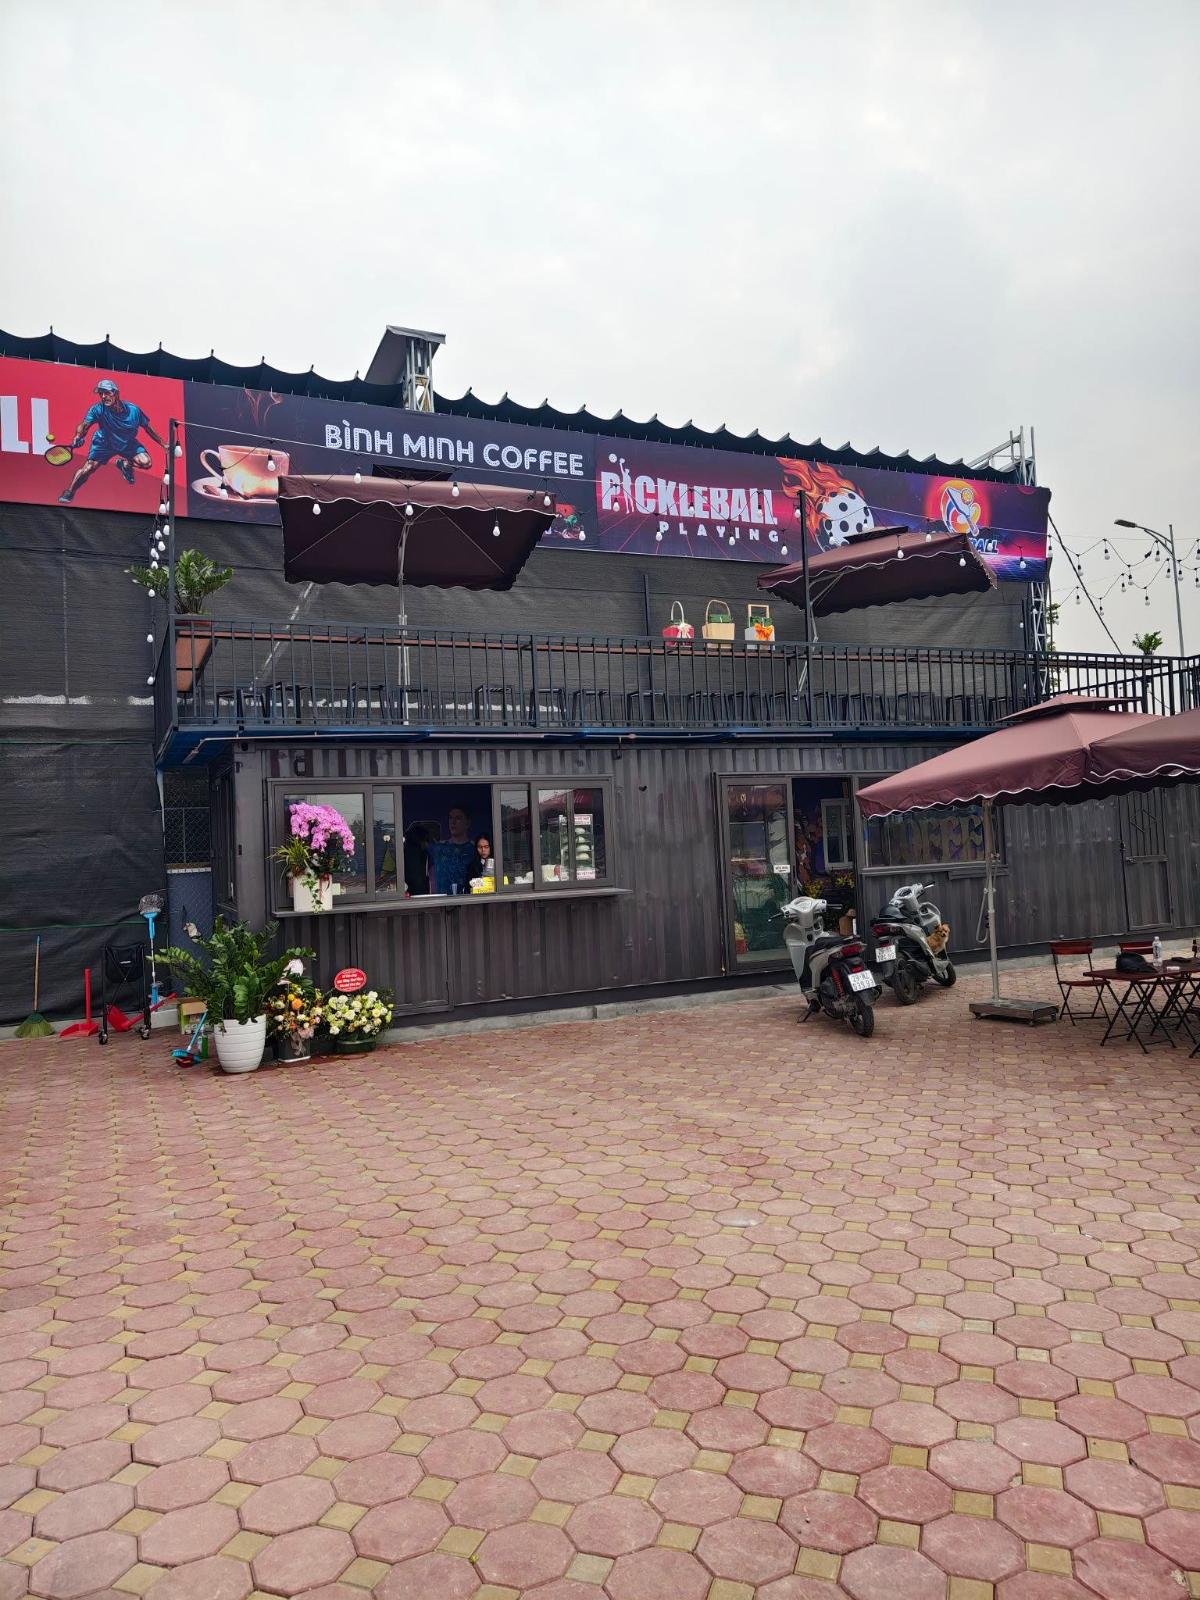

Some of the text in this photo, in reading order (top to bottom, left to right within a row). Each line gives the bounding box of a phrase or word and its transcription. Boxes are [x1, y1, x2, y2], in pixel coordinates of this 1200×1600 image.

[324, 419, 584, 476] BÌNH MINH COFFEE
[600, 471, 778, 525] PICKLEBALL
[659, 521, 779, 542] PLAYING
